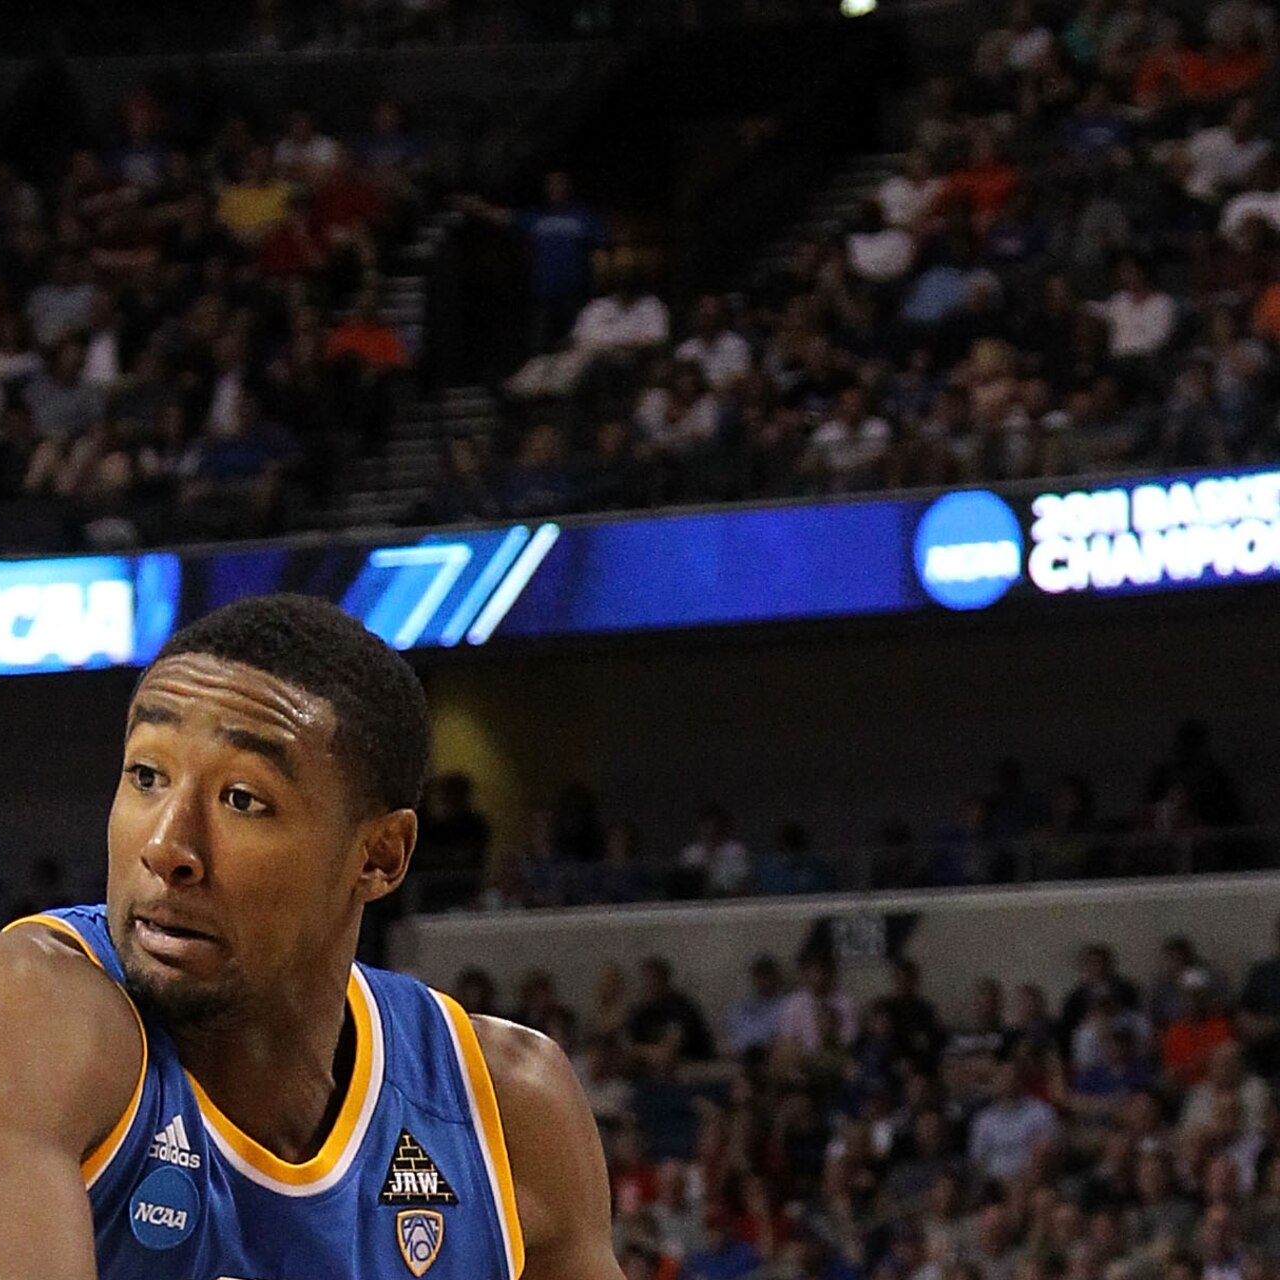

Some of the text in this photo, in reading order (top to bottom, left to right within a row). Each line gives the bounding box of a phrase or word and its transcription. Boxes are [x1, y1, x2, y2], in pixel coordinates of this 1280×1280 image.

[1028, 520, 1280, 593] CHAMPIO
[148, 1143, 201, 1169] adidas
[391, 1172, 438, 1195] JRW
[134, 1201, 188, 1231] NCAA
